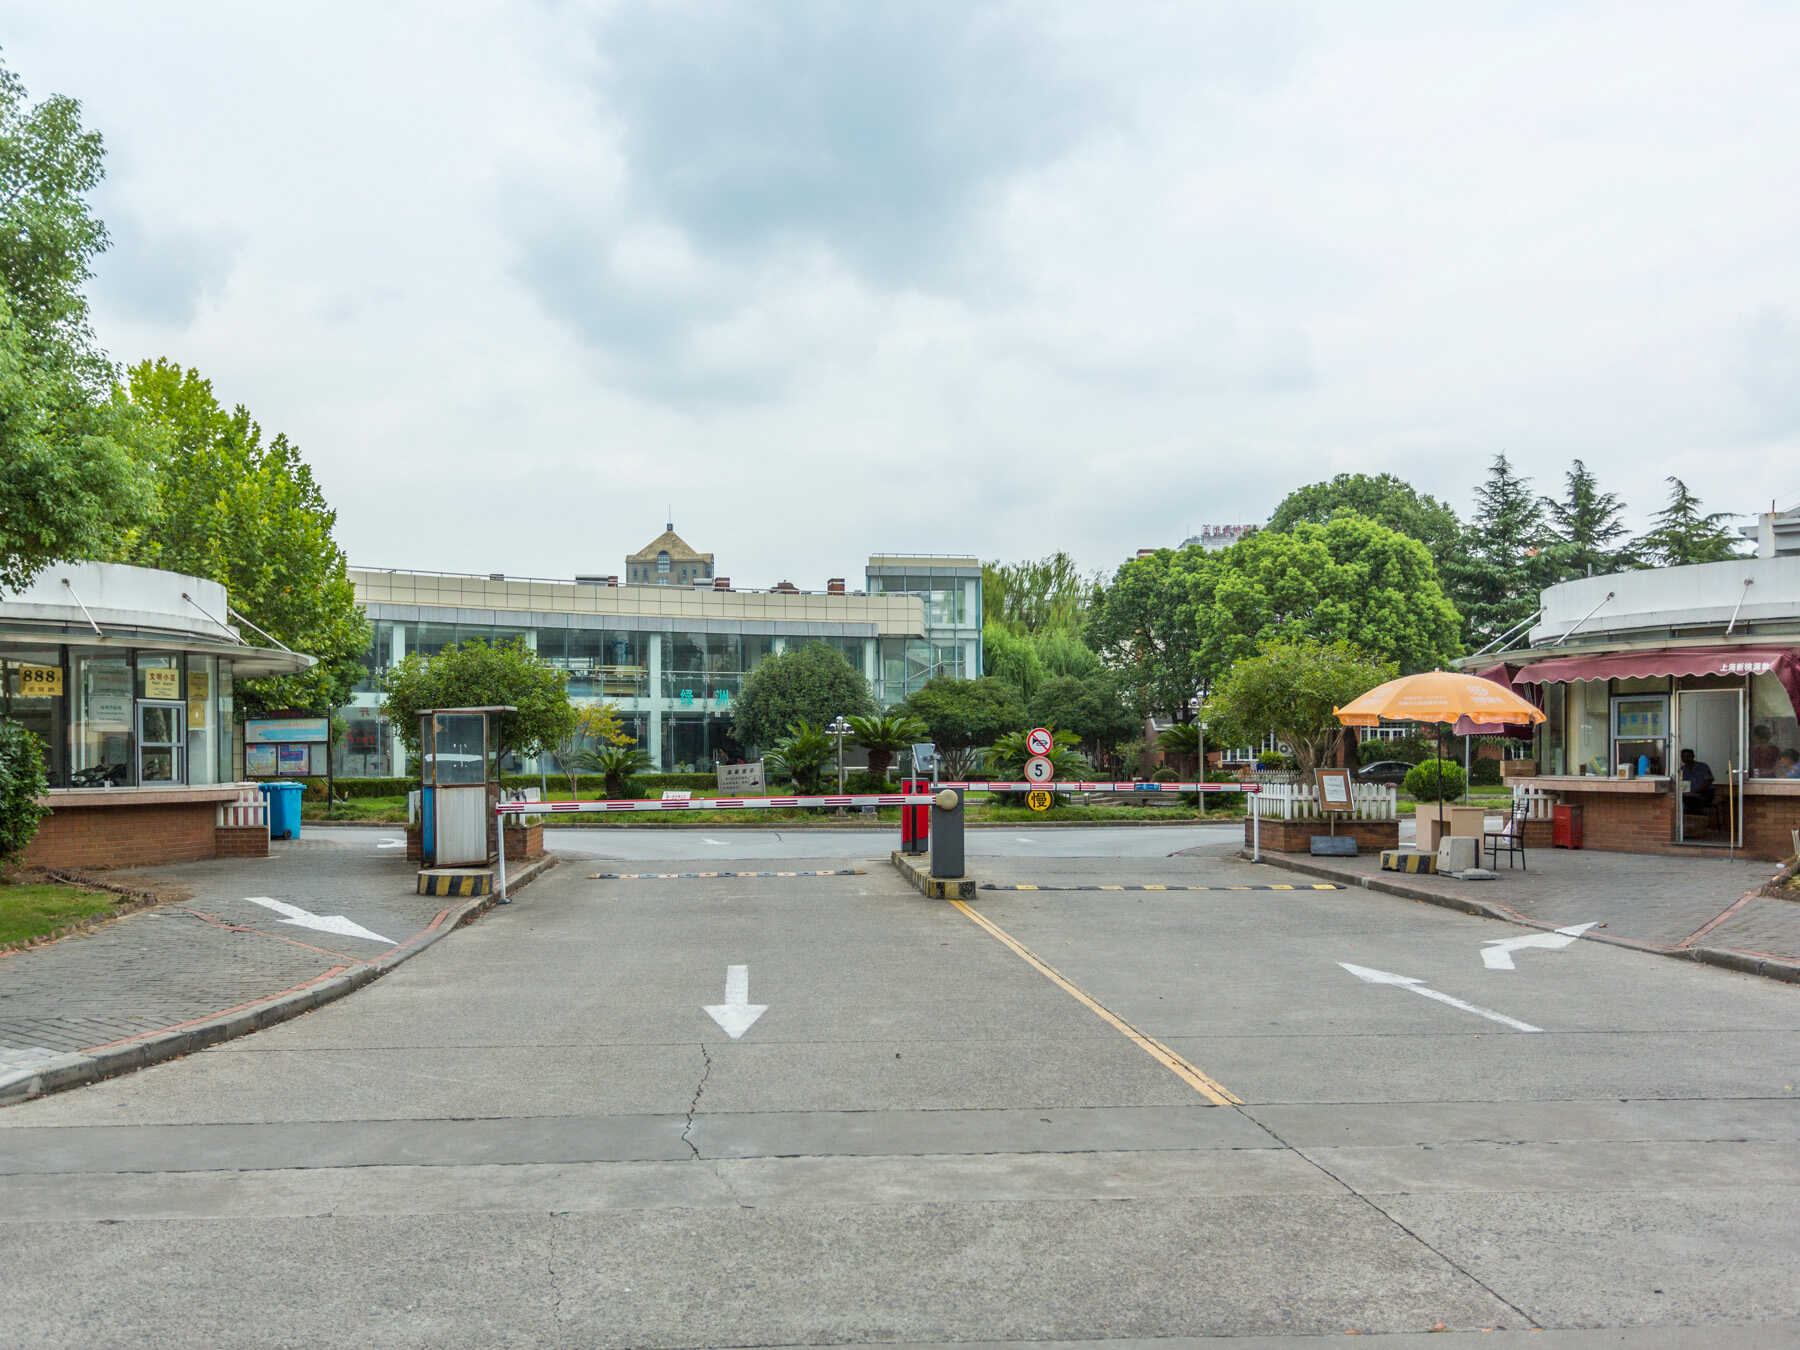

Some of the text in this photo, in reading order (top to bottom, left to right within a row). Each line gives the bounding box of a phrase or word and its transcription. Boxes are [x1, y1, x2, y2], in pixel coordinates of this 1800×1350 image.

[24, 670, 55, 683] 888
[1034, 764, 1043, 777] 5
[1031, 792, 1047, 808] 慢
